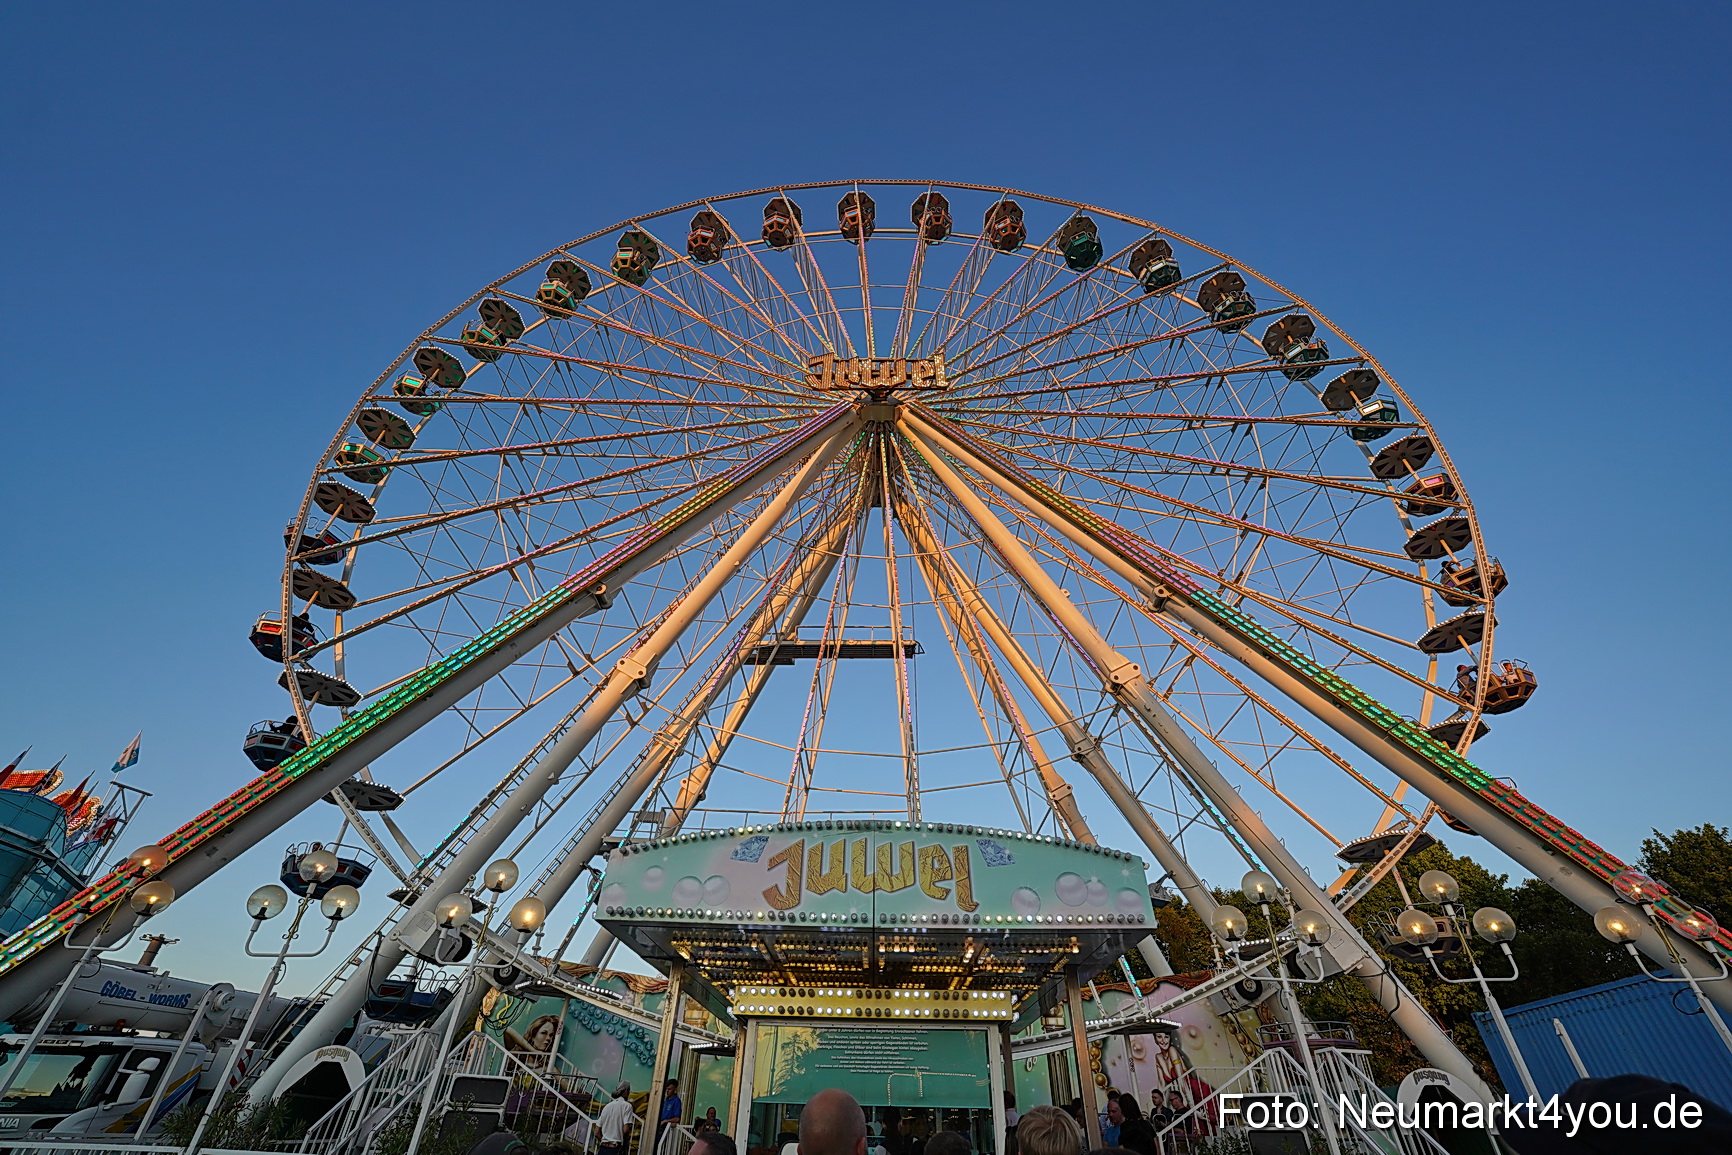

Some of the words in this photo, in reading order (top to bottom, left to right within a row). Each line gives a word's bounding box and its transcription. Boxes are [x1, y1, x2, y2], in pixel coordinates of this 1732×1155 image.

[804, 352, 950, 391] Juwel
[762, 837, 979, 912] Juwel
[100, 980, 138, 1001] GÖBEL
[148, 993, 192, 1008] WORMS
[314, 1047, 351, 1063] Ausgang
[1412, 1070, 1451, 1086] Ausgang
